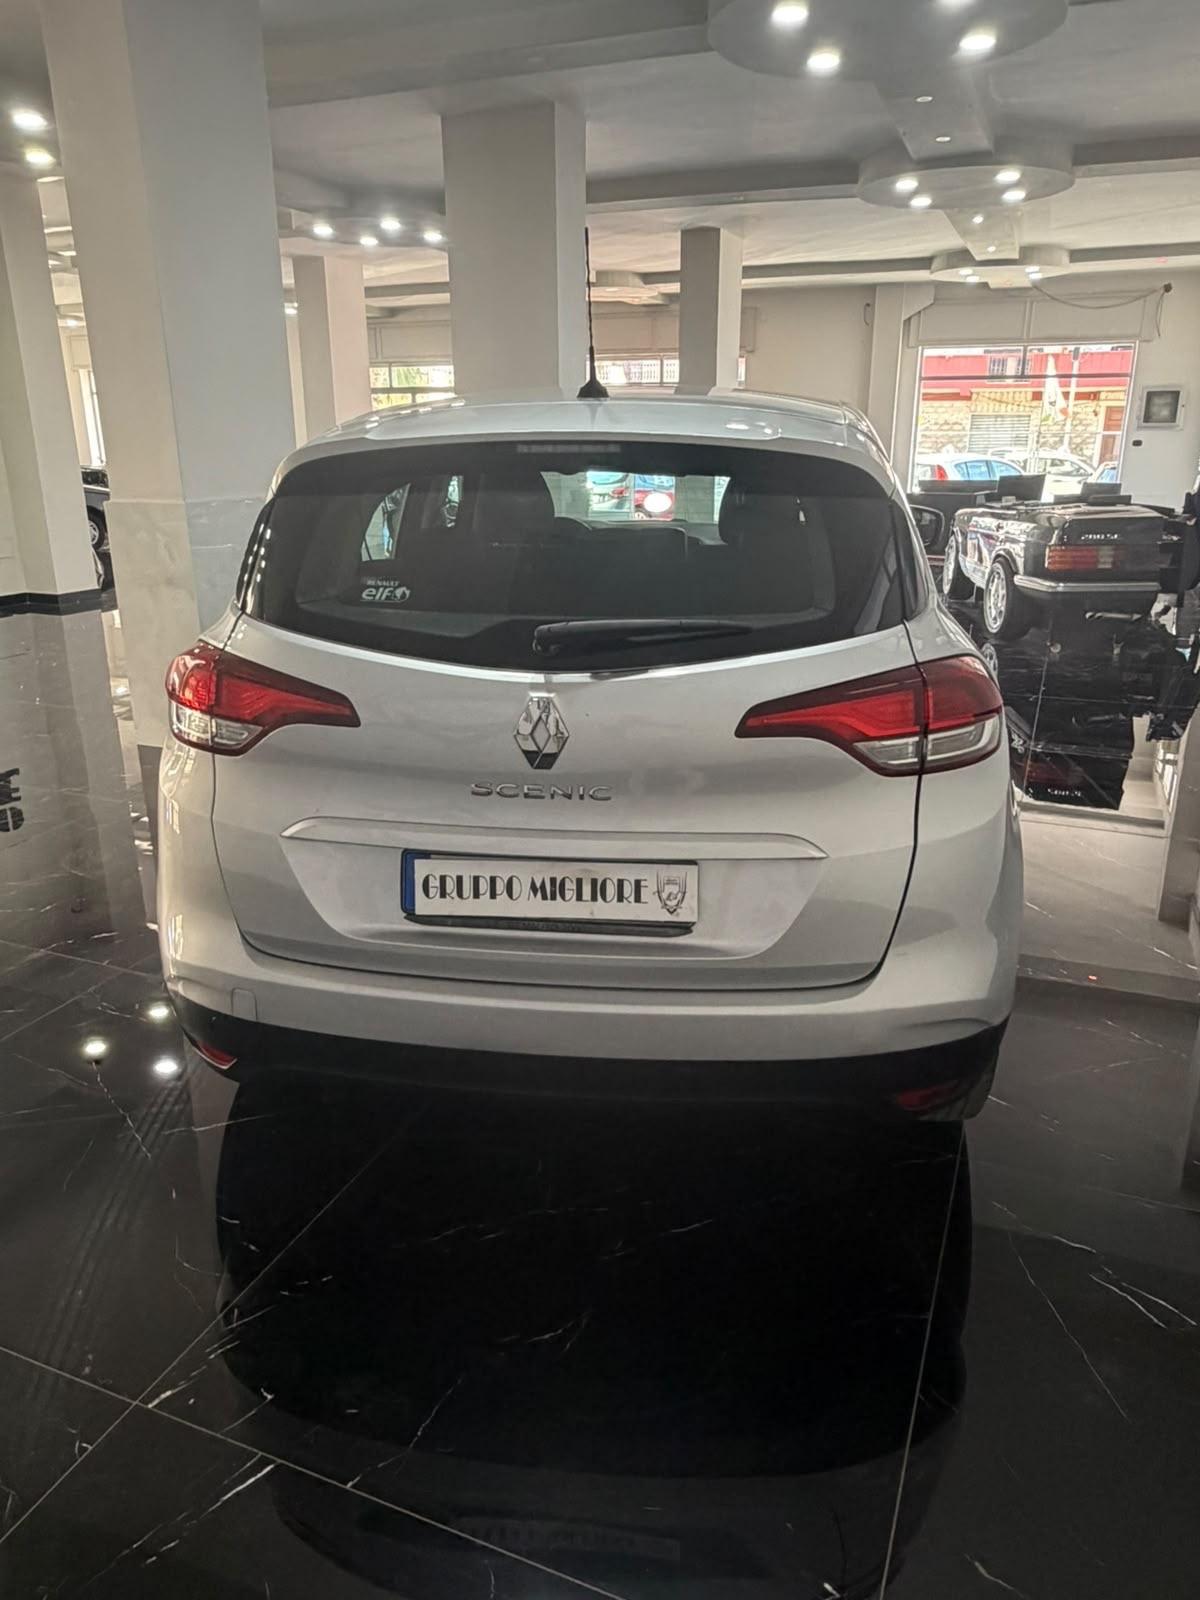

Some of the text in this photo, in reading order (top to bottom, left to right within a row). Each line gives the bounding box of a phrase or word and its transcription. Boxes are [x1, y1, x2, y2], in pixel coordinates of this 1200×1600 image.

[361, 587, 394, 601] elf
[471, 783, 612, 801] SCENIC
[422, 873, 649, 904] GRUPPO MIGLIORE
